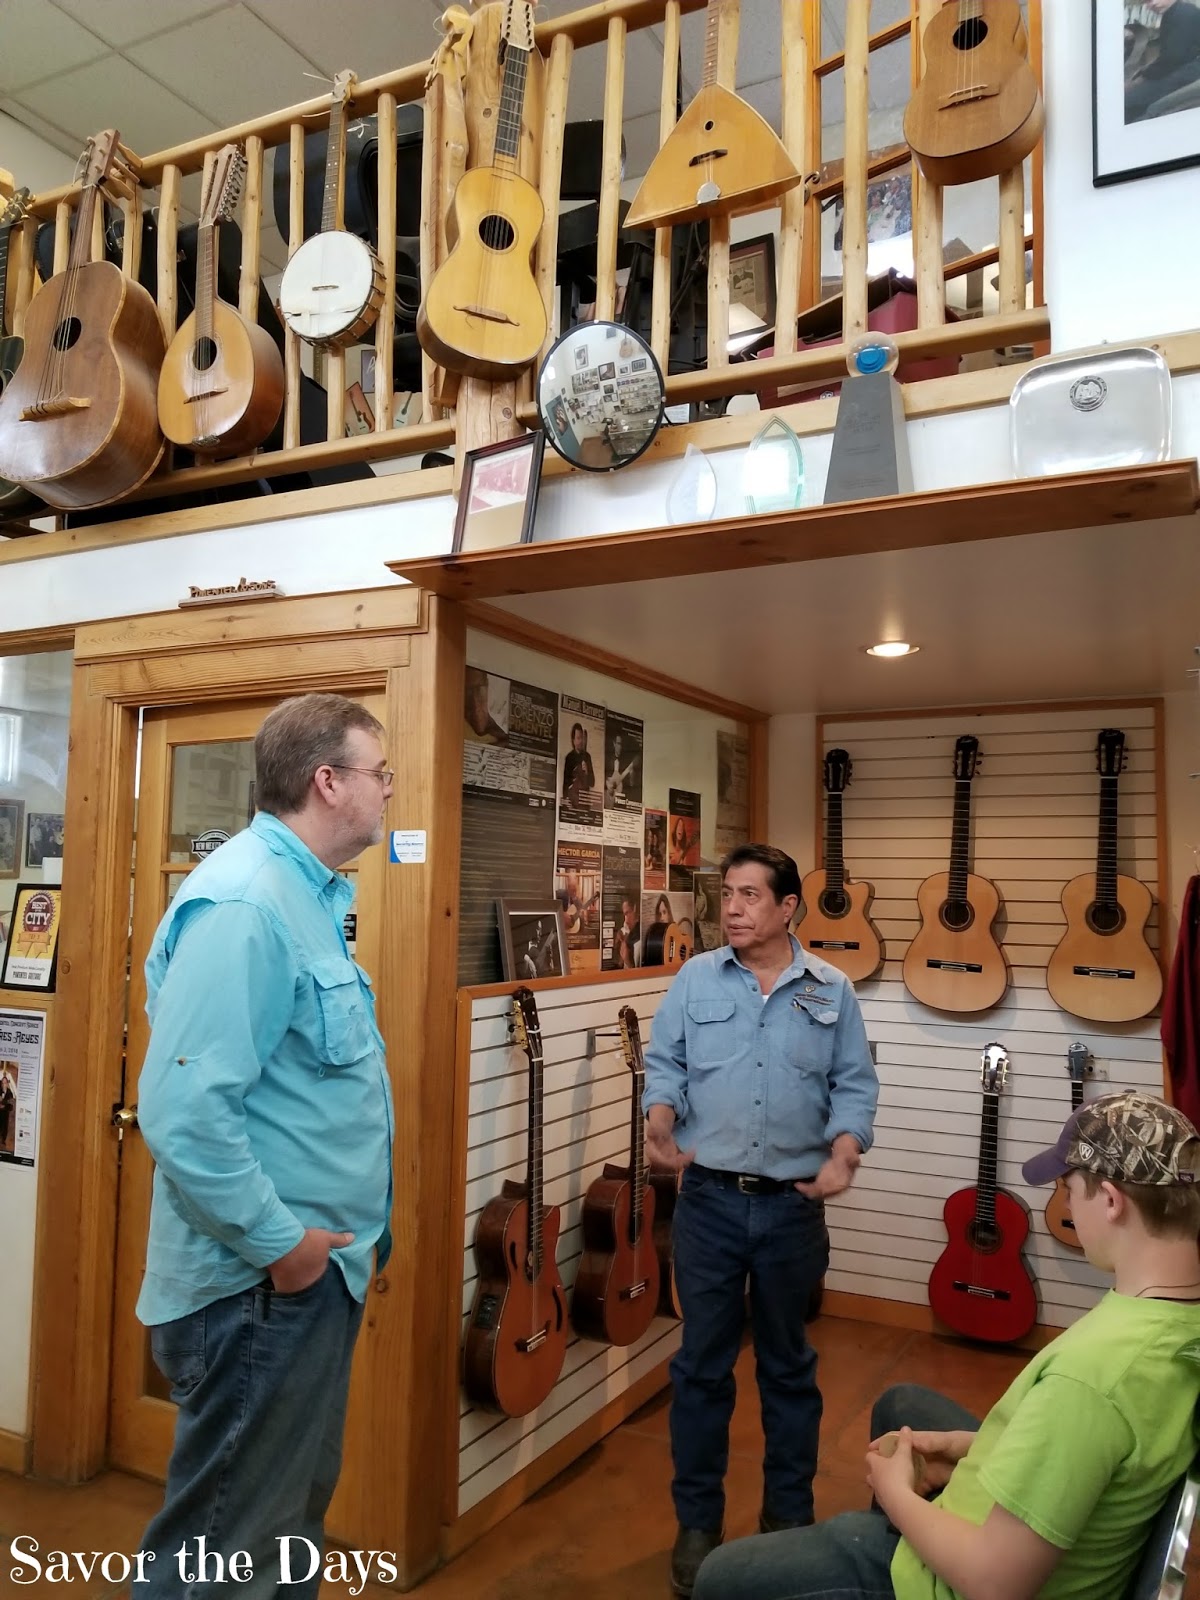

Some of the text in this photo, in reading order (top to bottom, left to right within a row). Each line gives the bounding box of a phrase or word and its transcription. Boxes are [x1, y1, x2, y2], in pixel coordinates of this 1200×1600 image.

[510, 703, 554, 727] LORENZO
[510, 718, 554, 739] PIMENTEL
[558, 847, 581, 857] HECTOR
[31, 901, 48, 910] BEST
[25, 912, 51, 926] CITY
